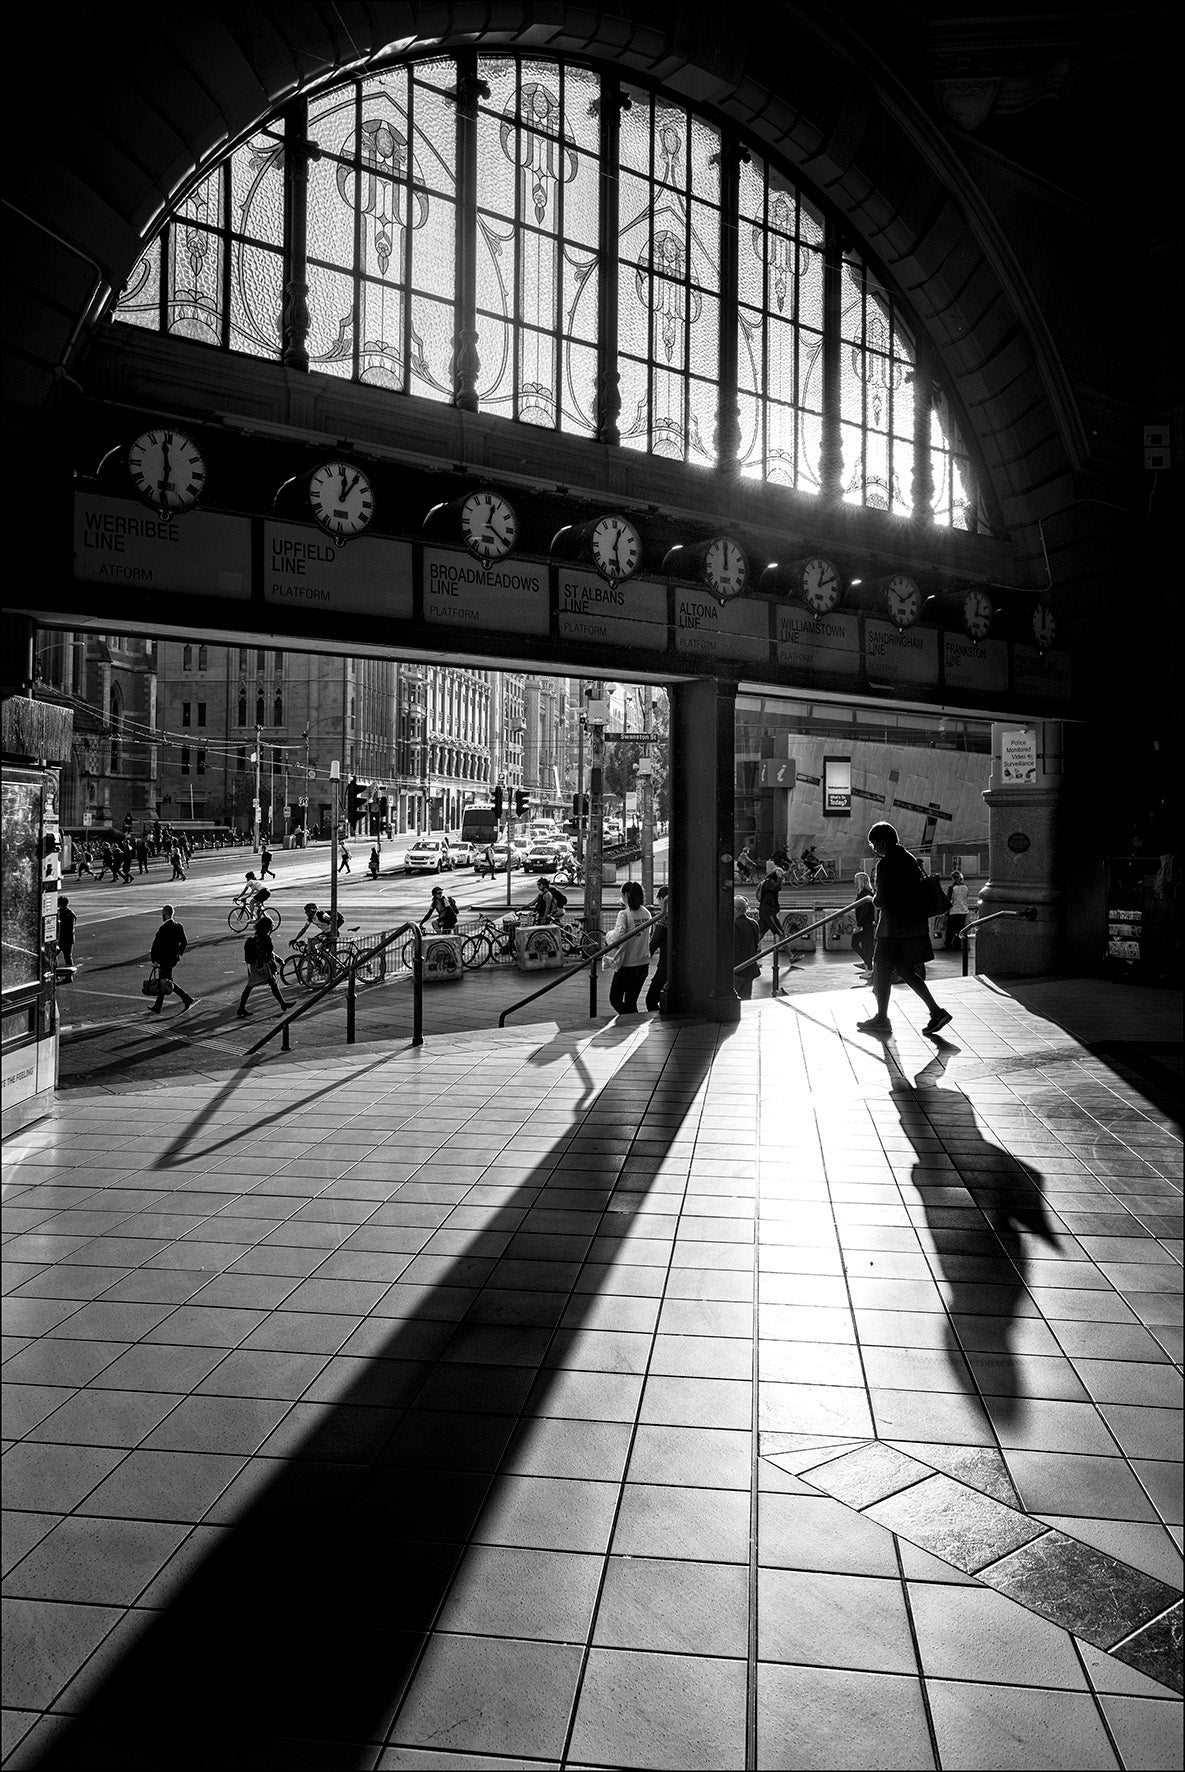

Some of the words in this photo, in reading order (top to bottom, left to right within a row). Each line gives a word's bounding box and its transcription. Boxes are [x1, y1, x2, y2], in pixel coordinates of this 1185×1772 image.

[85, 512, 180, 542] WERRIBEE
[83, 530, 126, 552] LINE
[272, 539, 336, 563] UPFIELD
[272, 555, 306, 575] LINE
[429, 563, 540, 592] BROADMEADOWS
[272, 584, 331, 601] PLATFORM
[430, 580, 459, 597] LINE
[564, 584, 579, 598] ST
[581, 587, 625, 605] ALBANS
[429, 605, 480, 620] PLATFORM
[564, 598, 589, 613] LINE
[679, 602, 719, 619] ALTONA
[563, 622, 607, 636] PLATFORM
[679, 615, 701, 629] LINE
[780, 618, 846, 637] WILLIAMSTOWN
[780, 630, 800, 643] LINE
[868, 630, 924, 649] SANDRINGHAM
[946, 643, 987, 660] FRANKSTON
[650, 733, 657, 741] St
[1003, 760, 1035, 768] Surveillance
[829, 799, 848, 807] Today?
[7, 1074, 16, 1086] THE
[16, 1065, 35, 1082] FEELING
